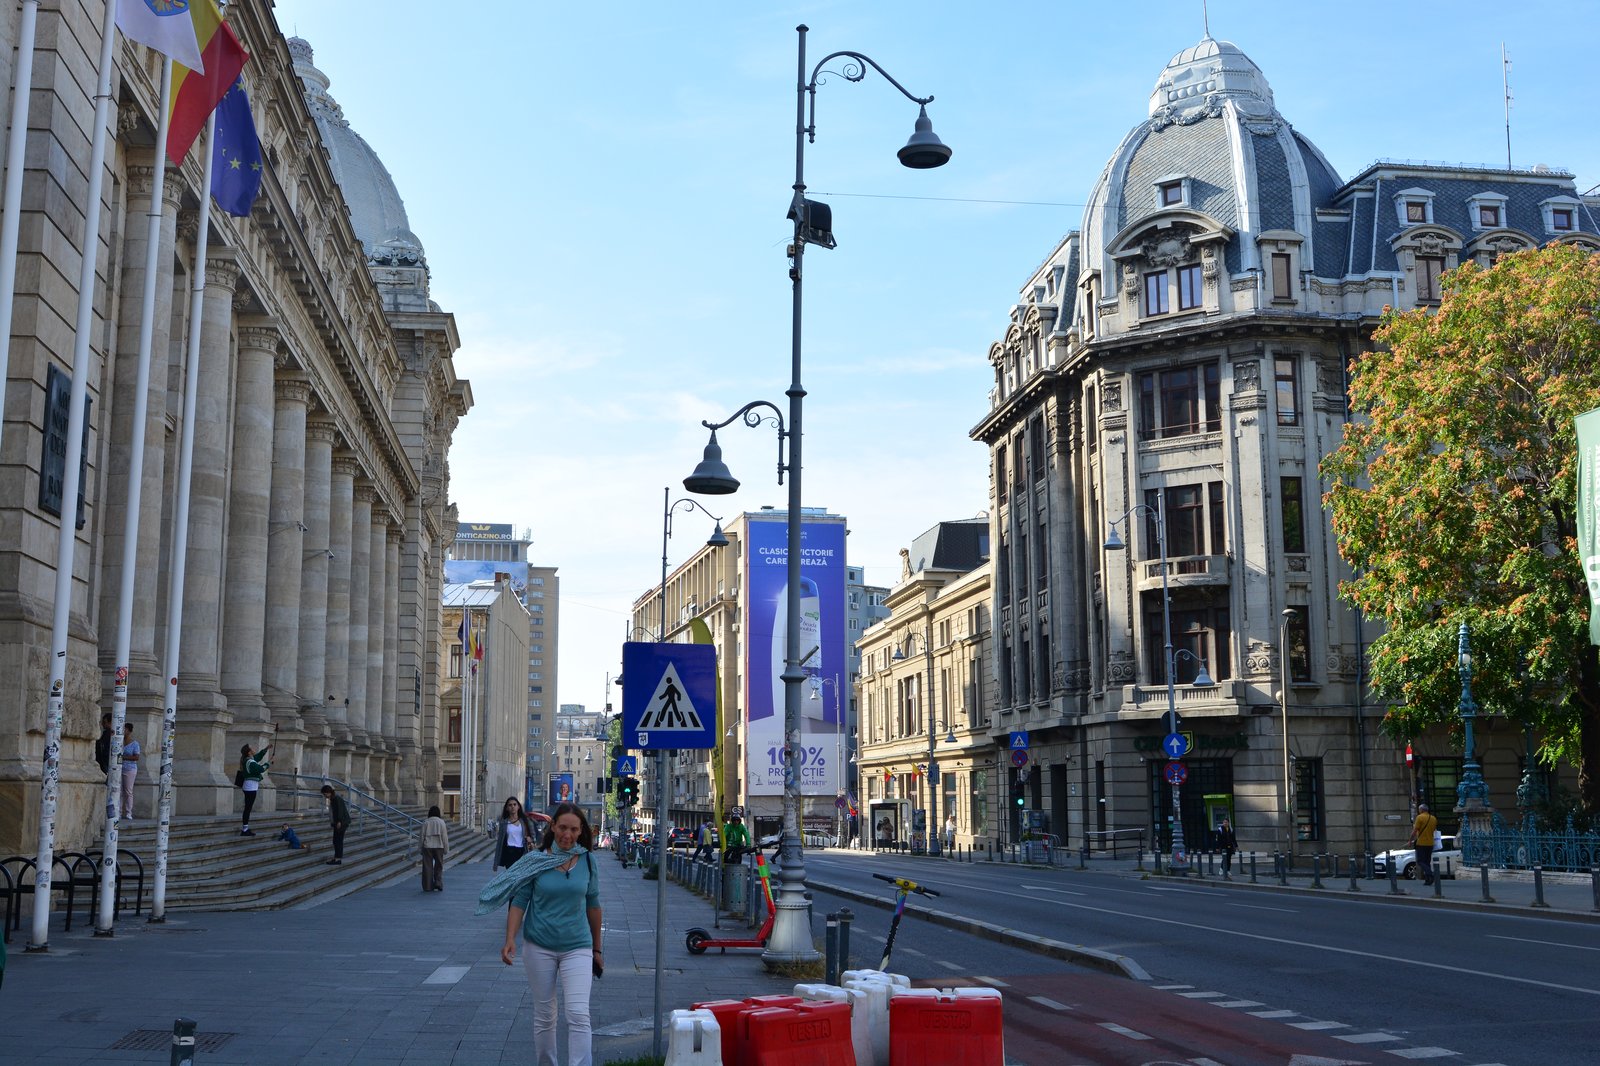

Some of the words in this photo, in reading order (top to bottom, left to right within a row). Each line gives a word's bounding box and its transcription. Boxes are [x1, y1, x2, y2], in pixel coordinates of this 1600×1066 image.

[456, 532, 512, 540] ONTICAZINO.RO
[765, 557, 788, 565] CARE
[922, 1012, 969, 1028] VESTA
[790, 1021, 829, 1041] VESTA
